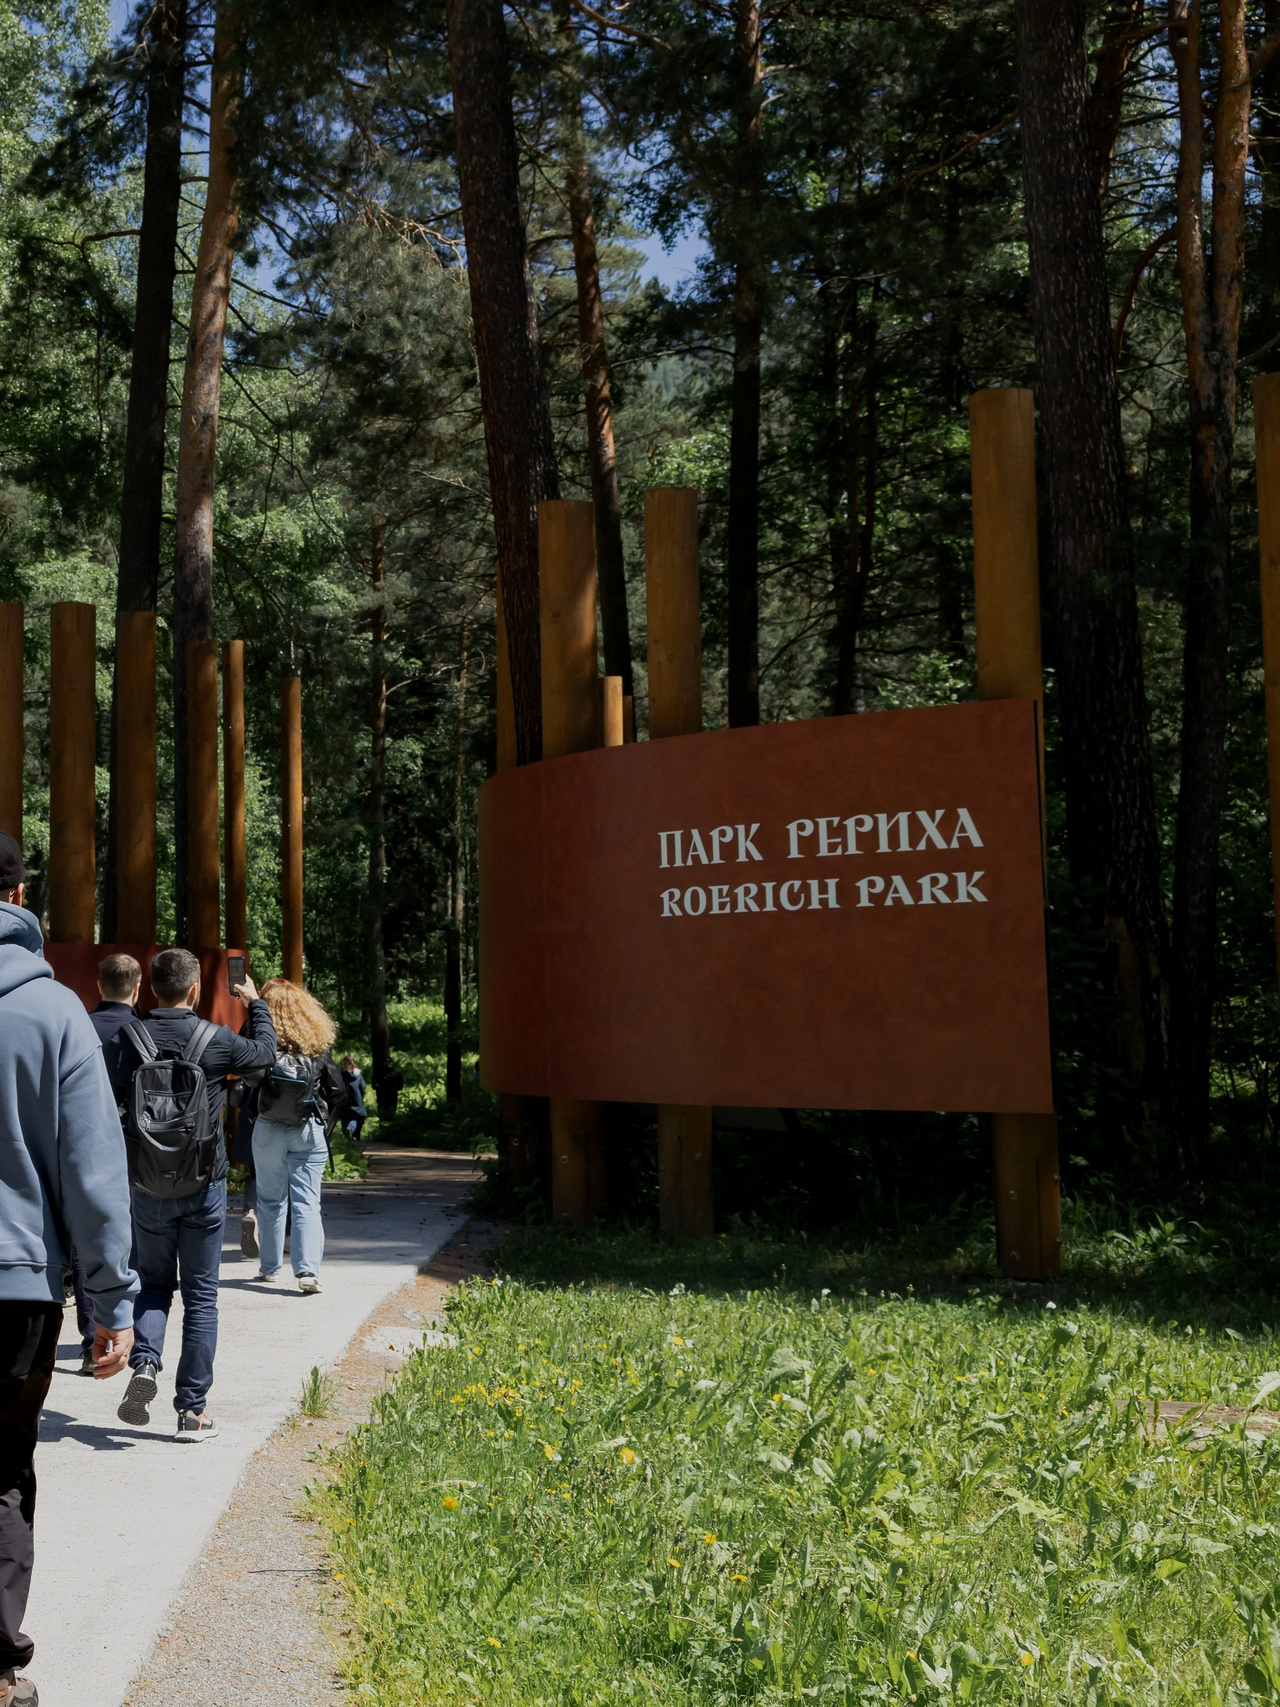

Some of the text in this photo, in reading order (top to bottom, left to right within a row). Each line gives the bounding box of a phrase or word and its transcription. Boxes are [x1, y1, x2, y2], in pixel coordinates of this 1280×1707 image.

[657, 807, 985, 869] ПАРК РЕРИХА
[659, 870, 989, 918] ROERICH PARK
